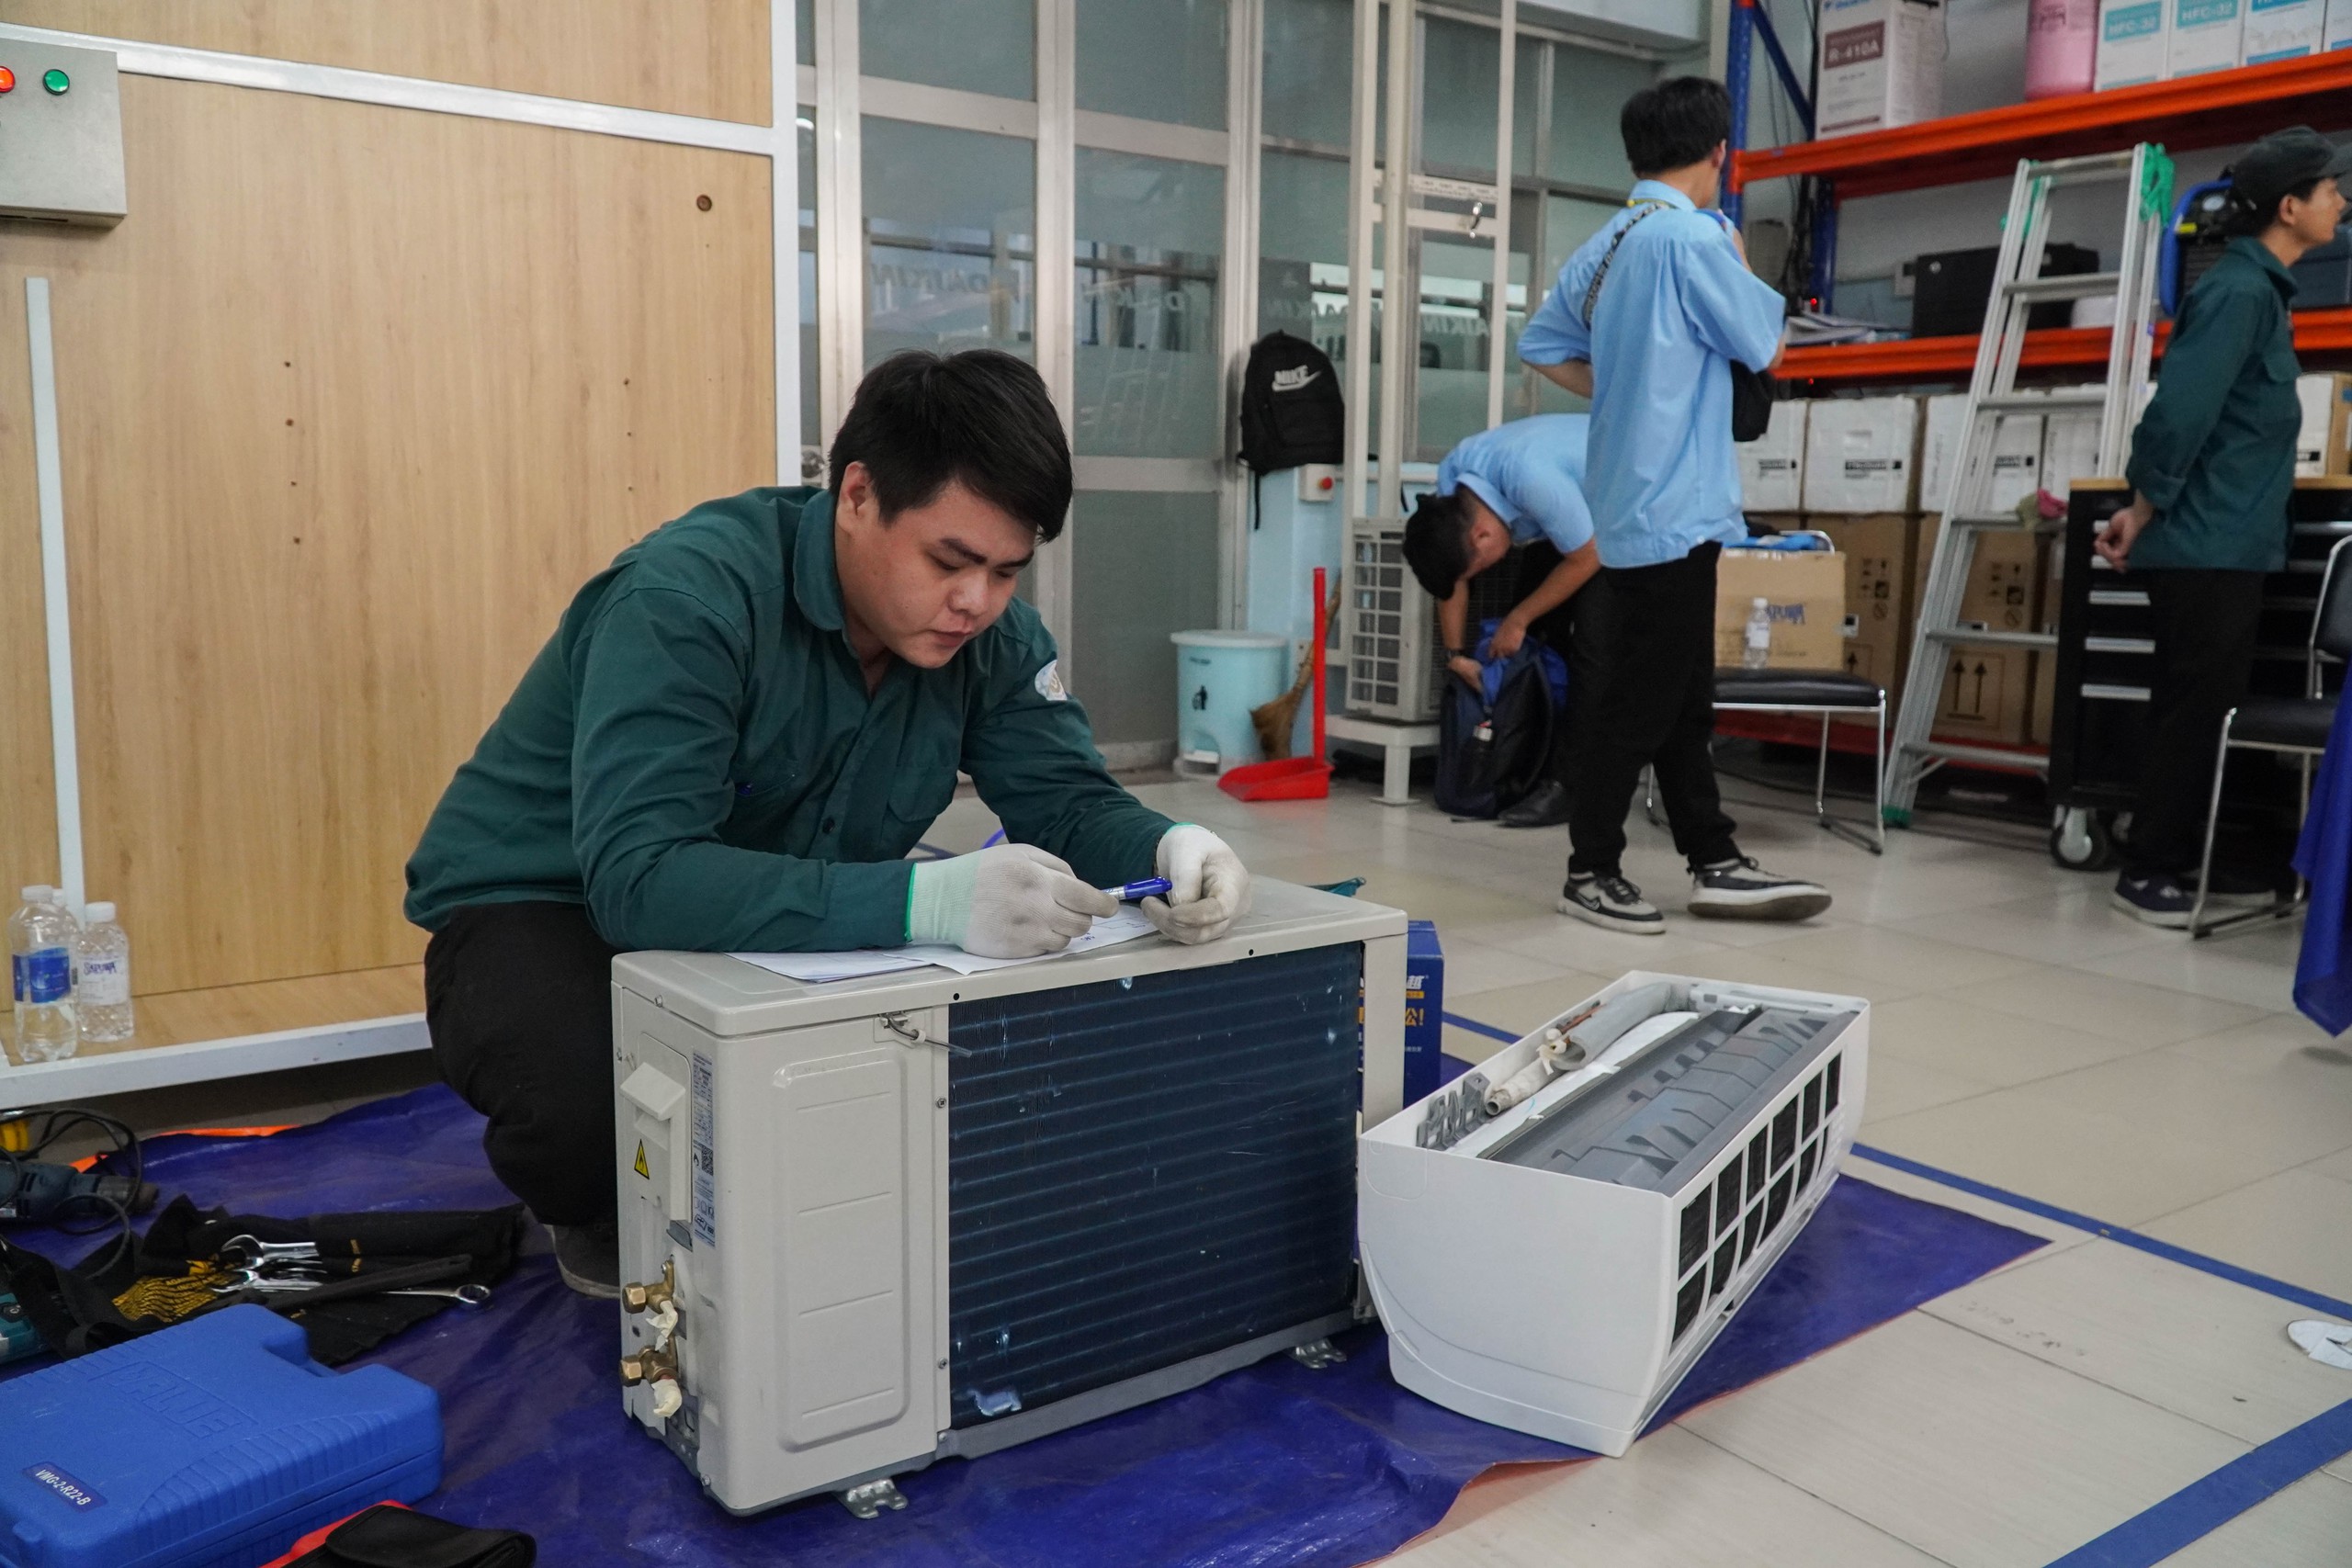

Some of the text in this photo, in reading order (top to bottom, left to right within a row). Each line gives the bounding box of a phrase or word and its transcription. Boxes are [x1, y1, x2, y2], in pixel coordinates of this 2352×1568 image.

[2181, 4, 2233, 21] HFC-32
[1827, 39, 1881, 63] R-410A
[1274, 365, 1308, 384] NIKE
[35, 1469, 92, 1506] VMG-2-R22-B
